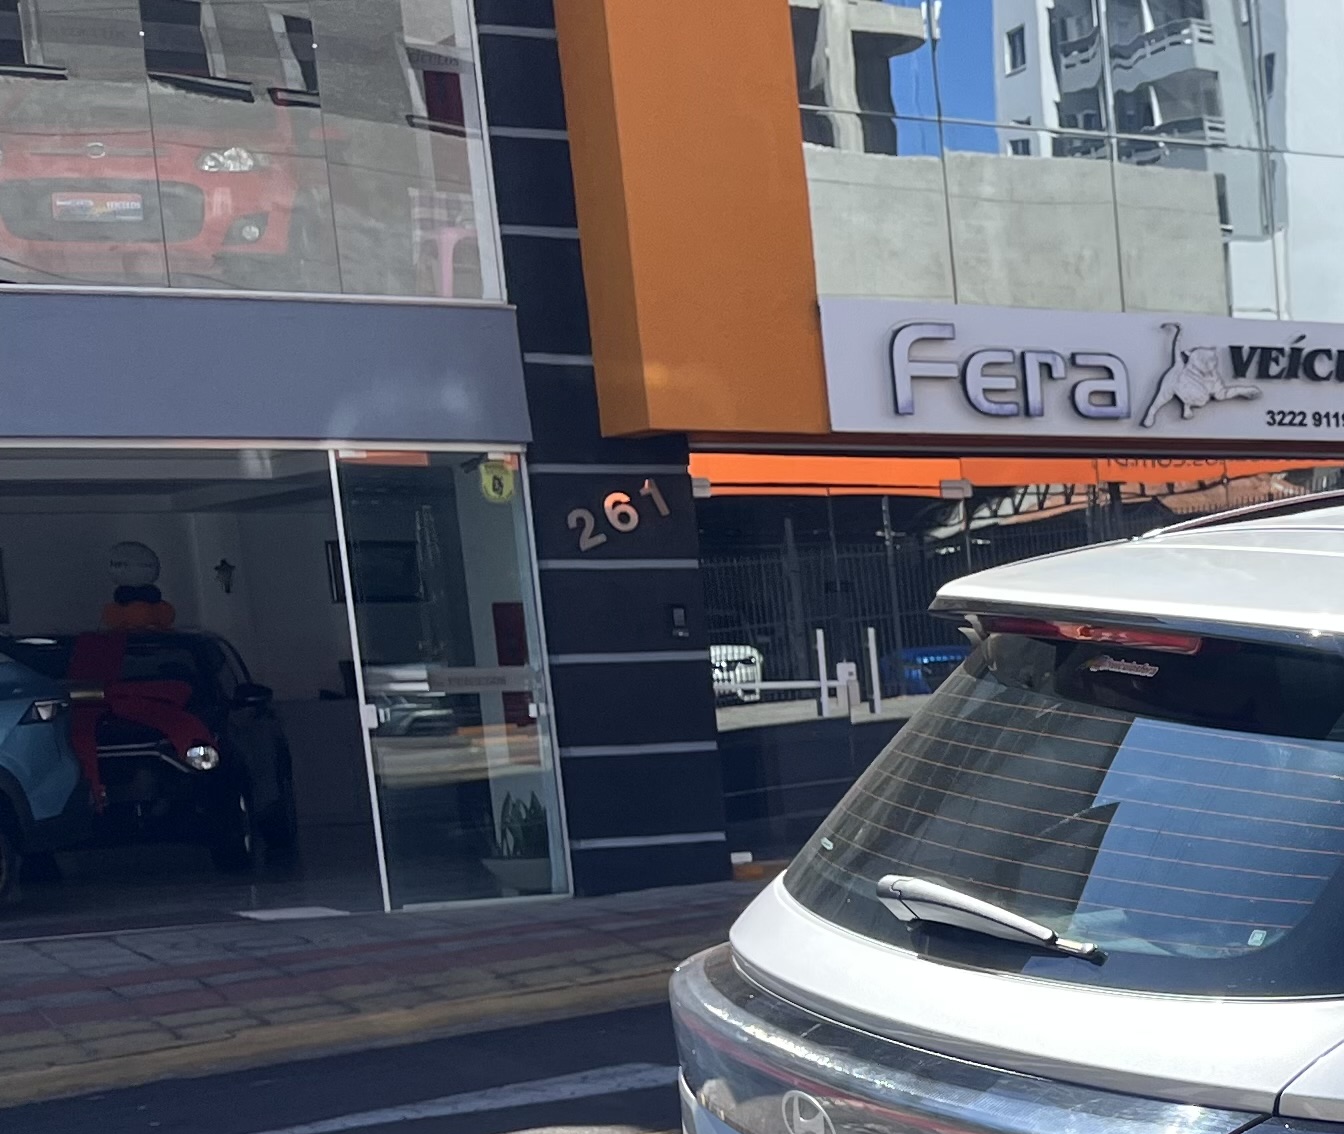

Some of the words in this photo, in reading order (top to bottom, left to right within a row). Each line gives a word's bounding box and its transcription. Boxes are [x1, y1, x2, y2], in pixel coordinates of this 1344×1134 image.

[889, 322, 1132, 418] Fera
[1265, 409, 1308, 429] 3222
[566, 478, 671, 552] 261
